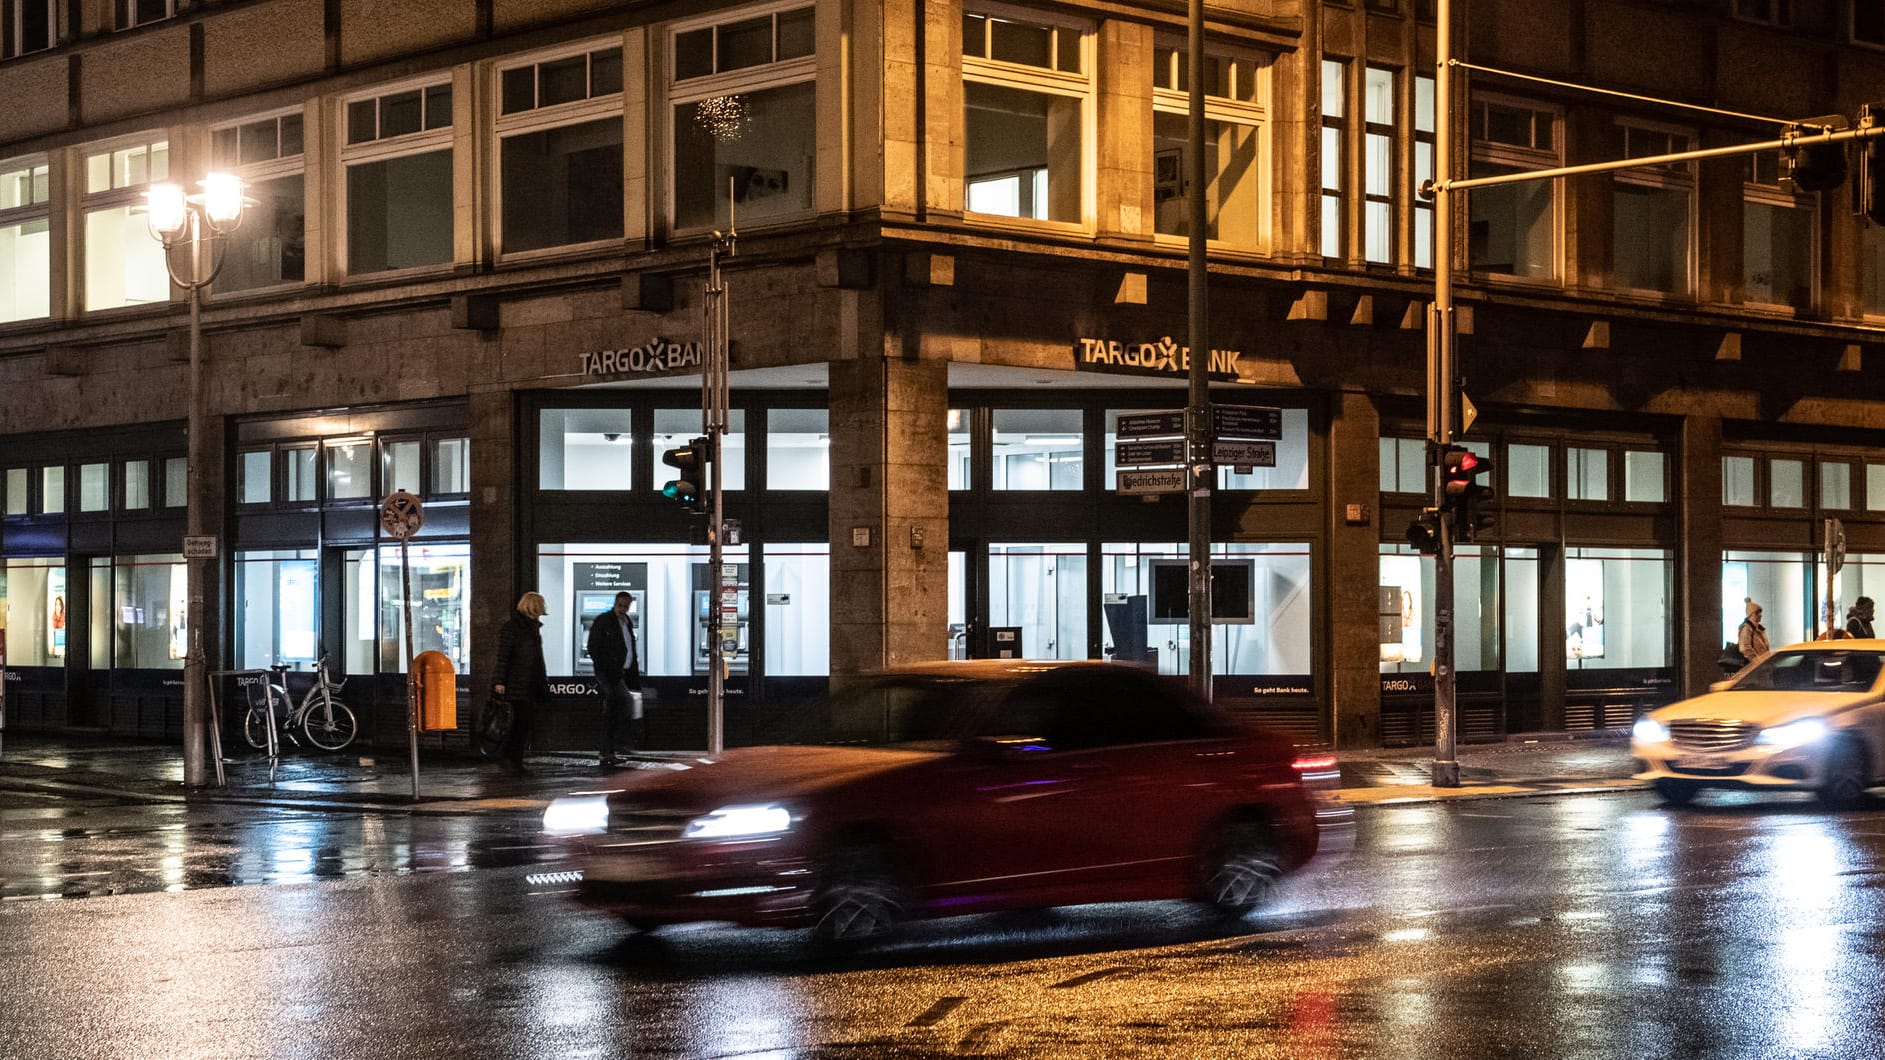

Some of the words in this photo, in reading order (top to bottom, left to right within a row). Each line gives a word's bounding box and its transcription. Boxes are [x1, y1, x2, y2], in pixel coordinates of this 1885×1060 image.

[579, 348, 644, 375] TARGO
[667, 341, 704, 367] BA
[1080, 338, 1156, 367] TARGO
[1182, 347, 1240, 373] BNK
[1213, 446, 1245, 461] Leipziger
[547, 683, 586, 695] ARGO
[1382, 680, 1409, 691] TARGO
